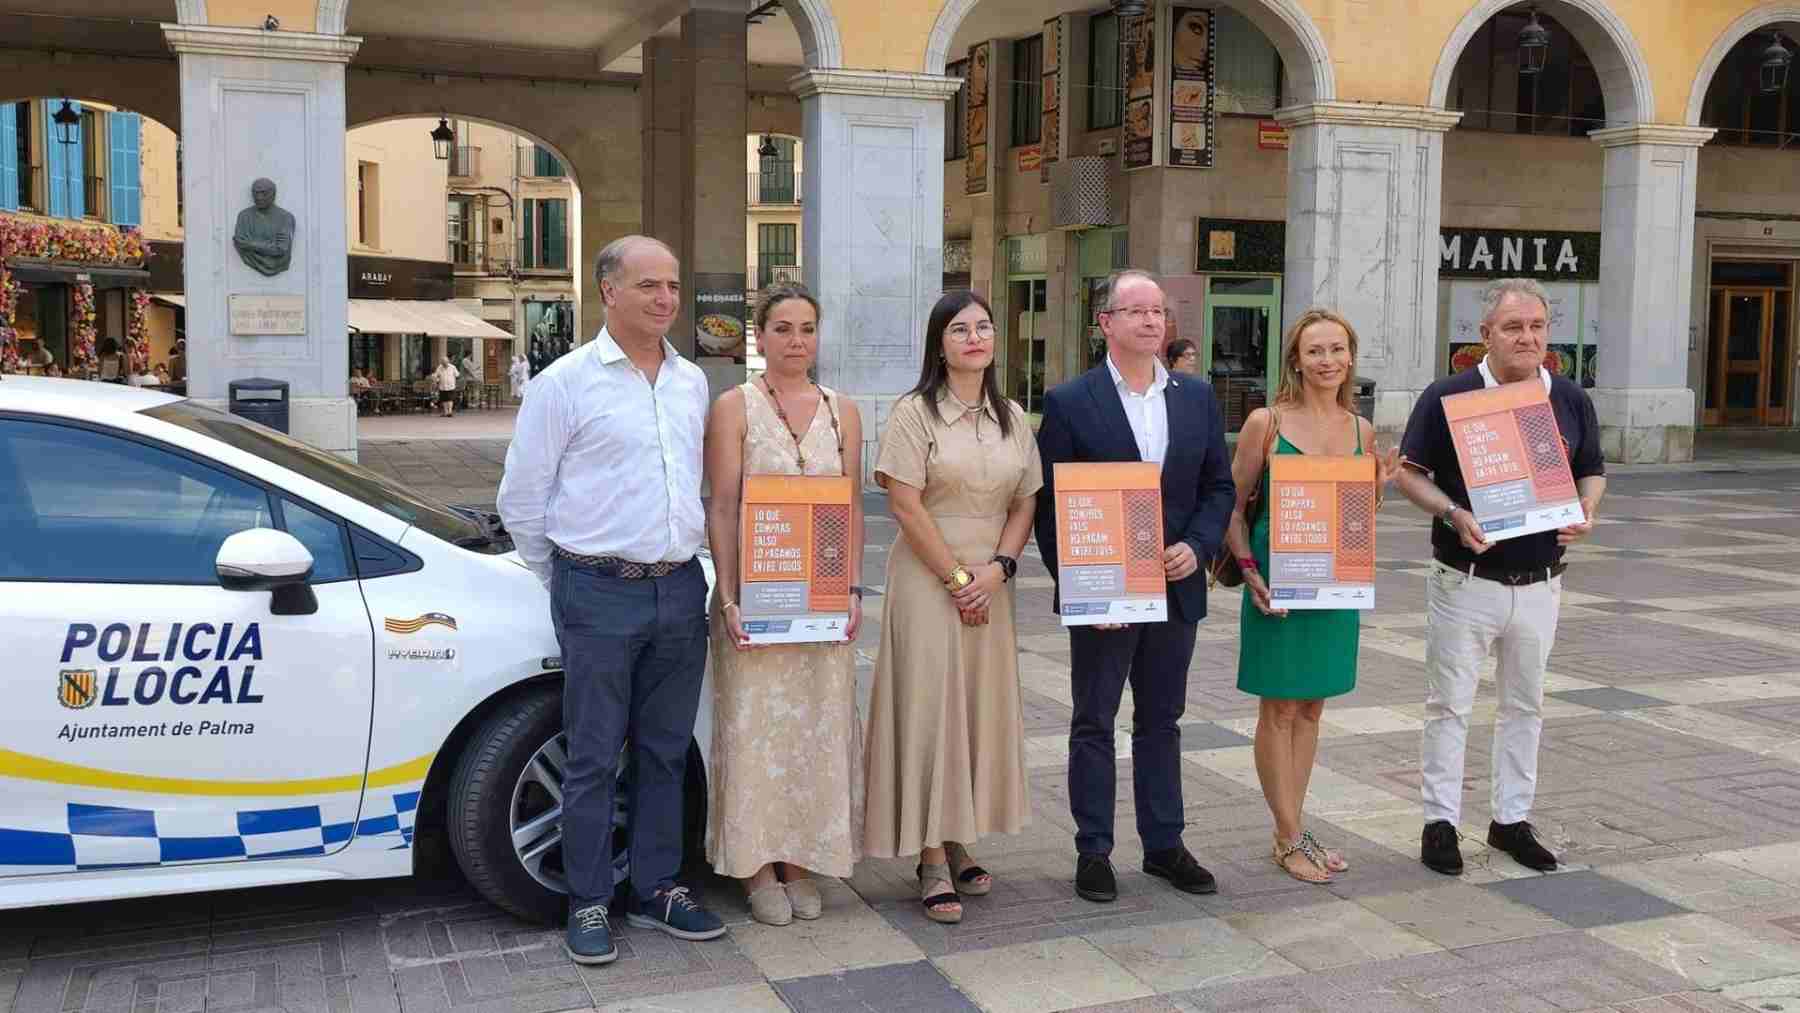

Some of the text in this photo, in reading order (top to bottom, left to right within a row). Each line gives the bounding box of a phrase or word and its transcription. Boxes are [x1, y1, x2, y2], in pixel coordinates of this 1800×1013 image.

[60, 622, 263, 663] POLICIA
[101, 665, 264, 706] LOCAL
[58, 720, 255, 742] Ajuntament de Palma
